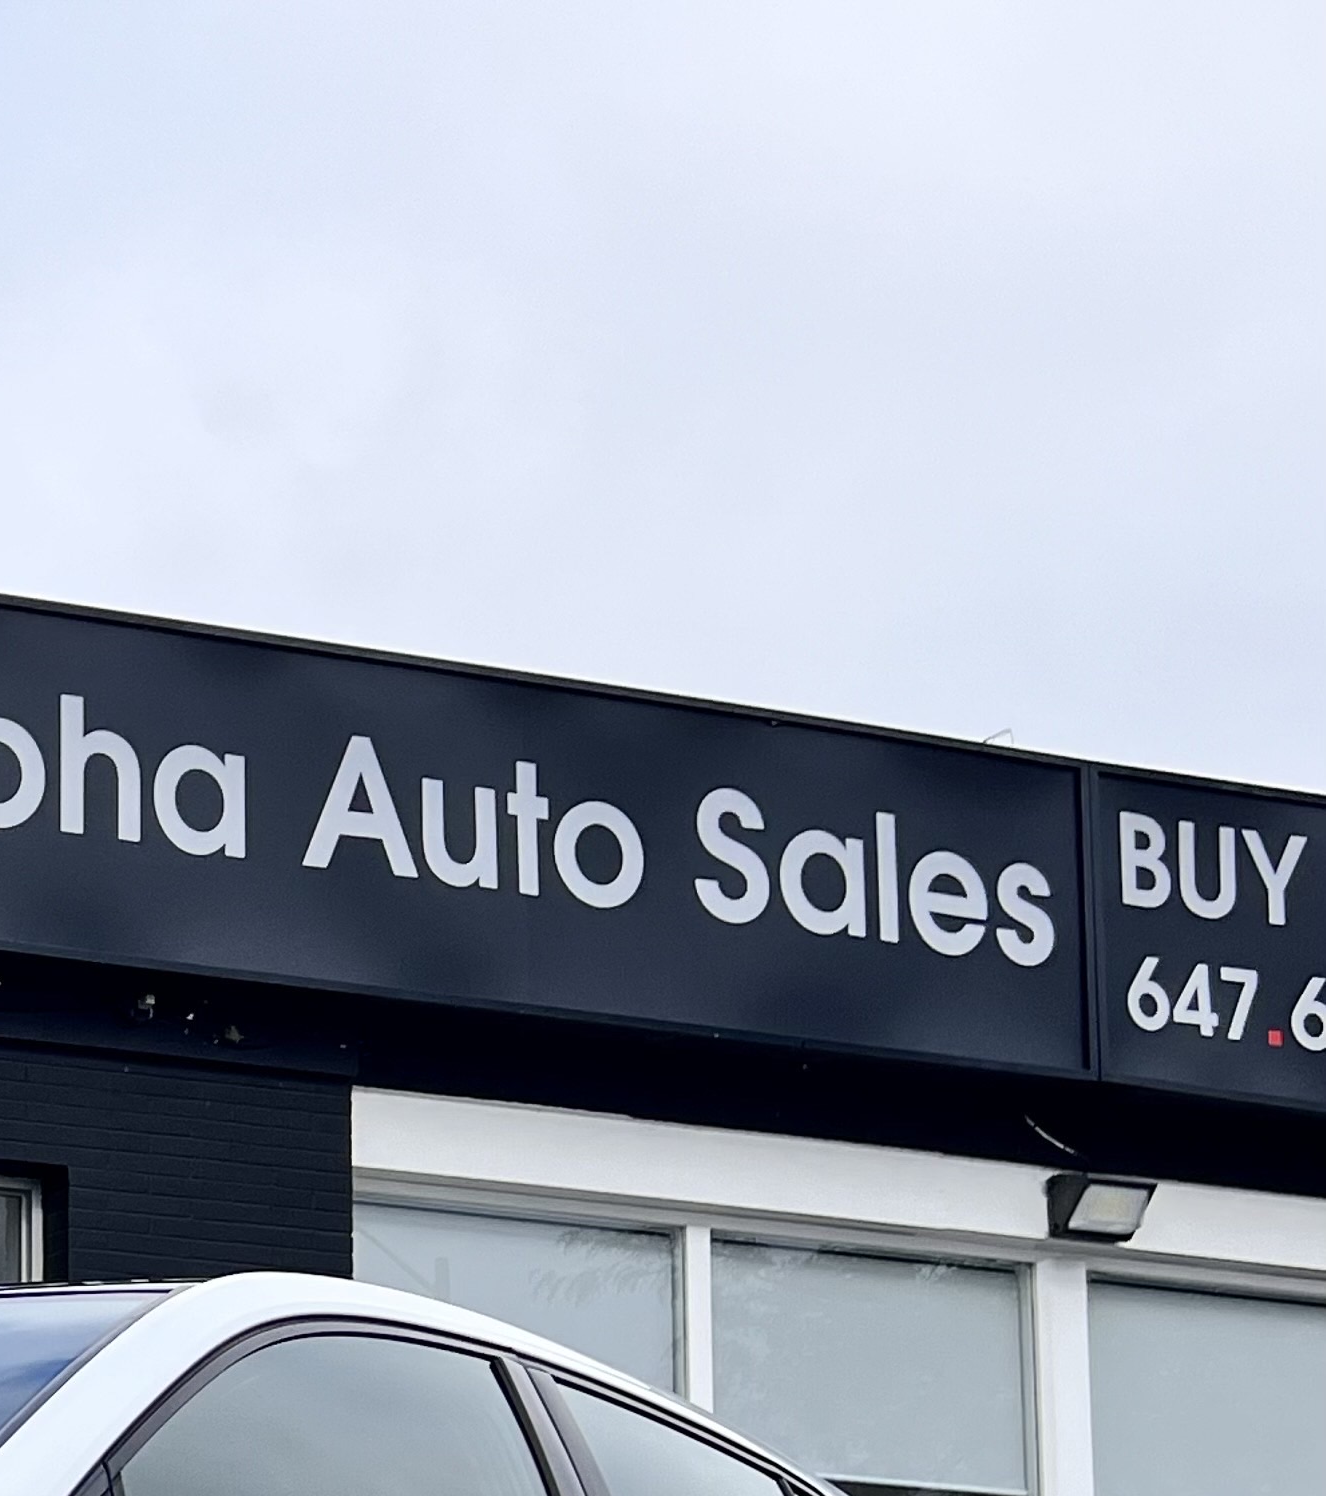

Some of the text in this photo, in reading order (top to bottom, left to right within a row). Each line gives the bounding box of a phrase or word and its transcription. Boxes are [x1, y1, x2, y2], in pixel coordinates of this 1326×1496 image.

[301, 735, 644, 909] Auto
[694, 787, 1055, 967] Sales
[1119, 810, 1308, 926] BUY
